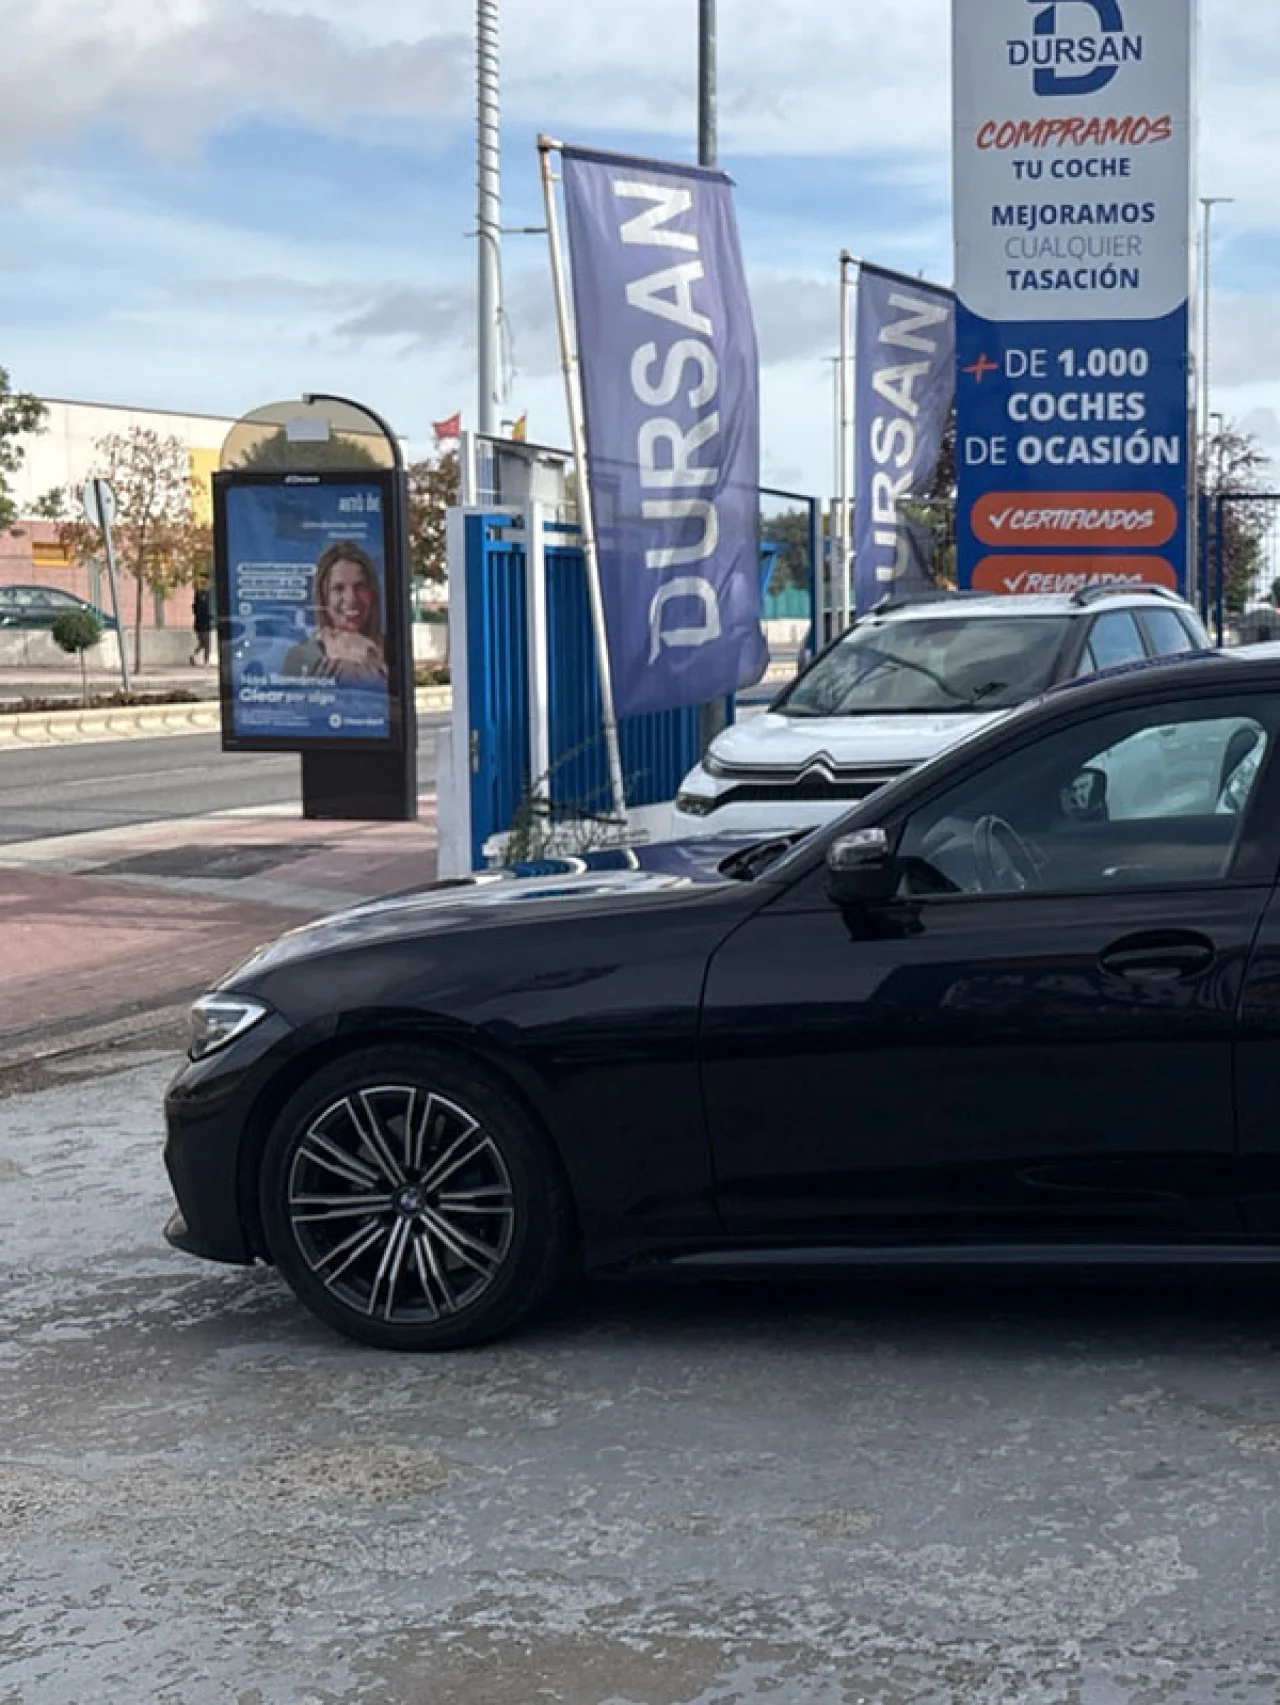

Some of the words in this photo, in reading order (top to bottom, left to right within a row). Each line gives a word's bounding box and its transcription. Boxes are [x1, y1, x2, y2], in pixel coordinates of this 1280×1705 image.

[1007, 35, 1142, 66] DURSAN
[976, 115, 1172, 150] COMPRAMOS
[1012, 160, 1042, 179] TU
[1051, 158, 1131, 178] COCHE
[992, 203, 1155, 230] MEJORAMOS
[1005, 235, 1142, 260] CUALQUIER
[1007, 263, 1139, 290] TASACIÓN
[1006, 349, 1048, 378] DE
[1057, 348, 1148, 377] 1.000
[1007, 392, 1145, 421] COCHES
[613, 179, 720, 666] DURSAN
[870, 292, 950, 598] URSAN
[965, 437, 1006, 465] DE
[1017, 429, 1180, 465] OCASIÓN
[1010, 508, 1154, 530] CERTIFICADOS
